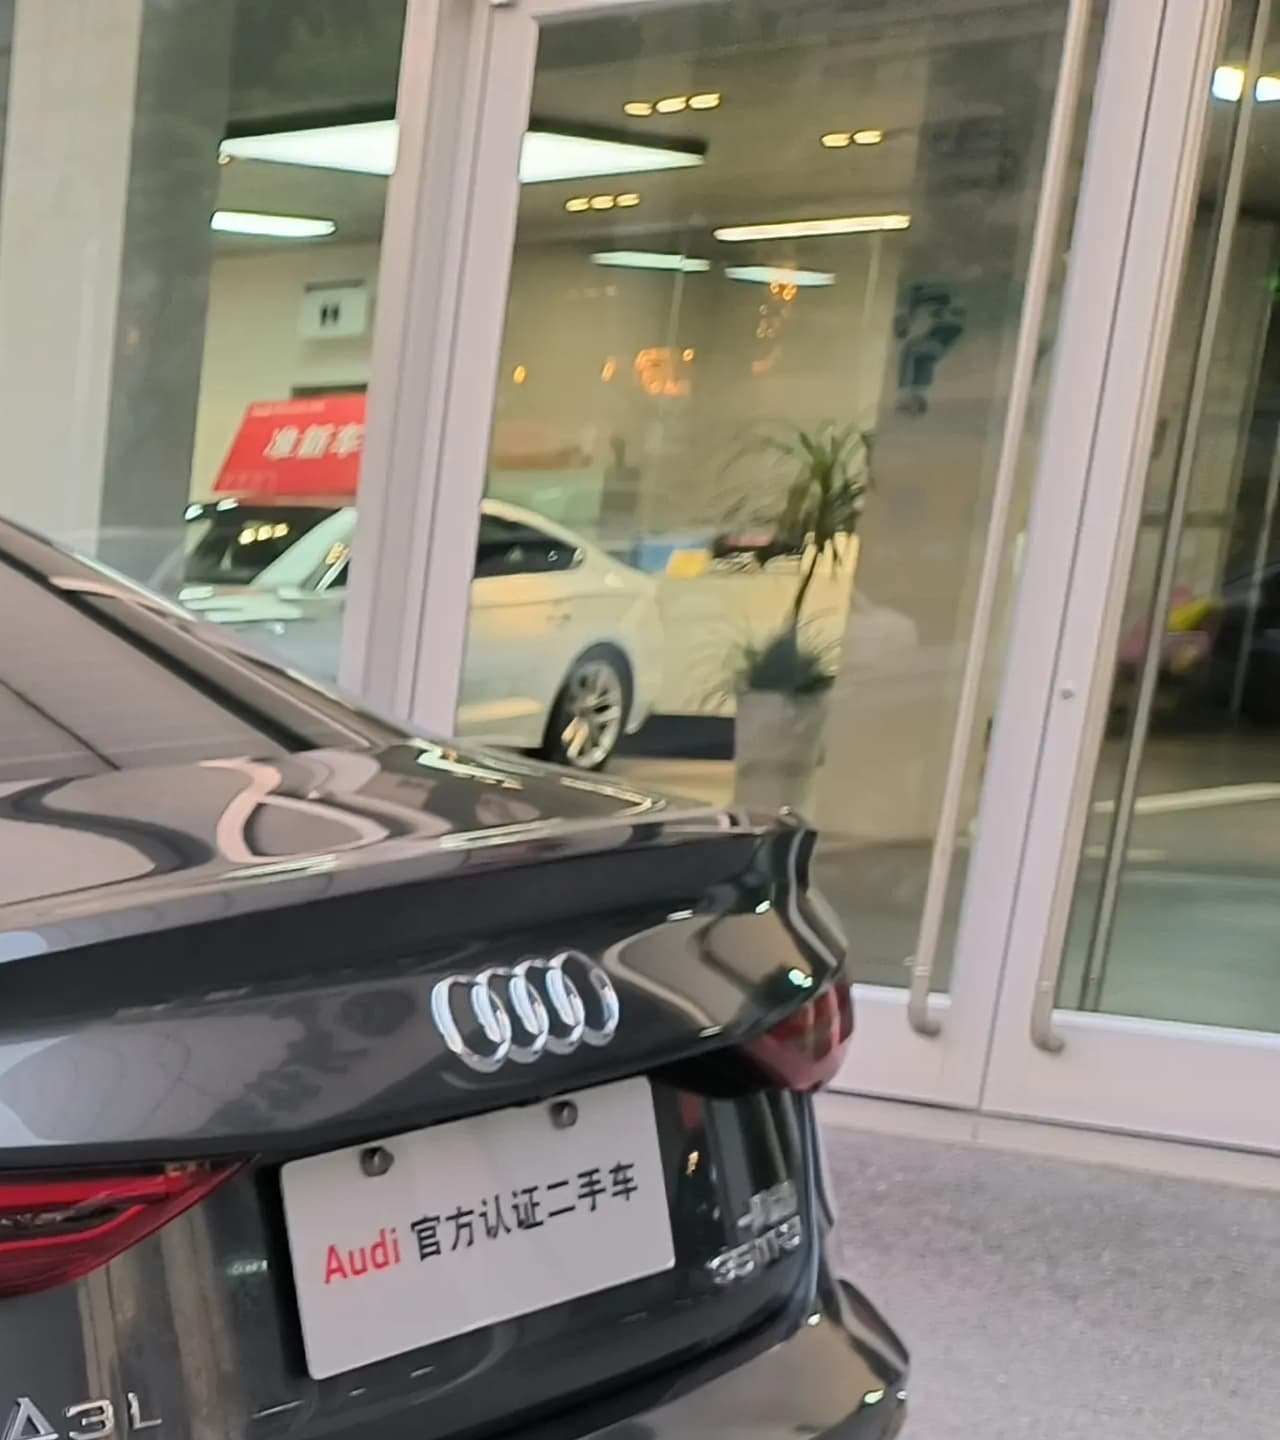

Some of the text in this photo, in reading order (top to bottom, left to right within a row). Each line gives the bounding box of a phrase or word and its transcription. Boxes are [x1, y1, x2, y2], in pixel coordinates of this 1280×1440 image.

[324, 1160, 639, 1284] Audi 官方认证二手车
